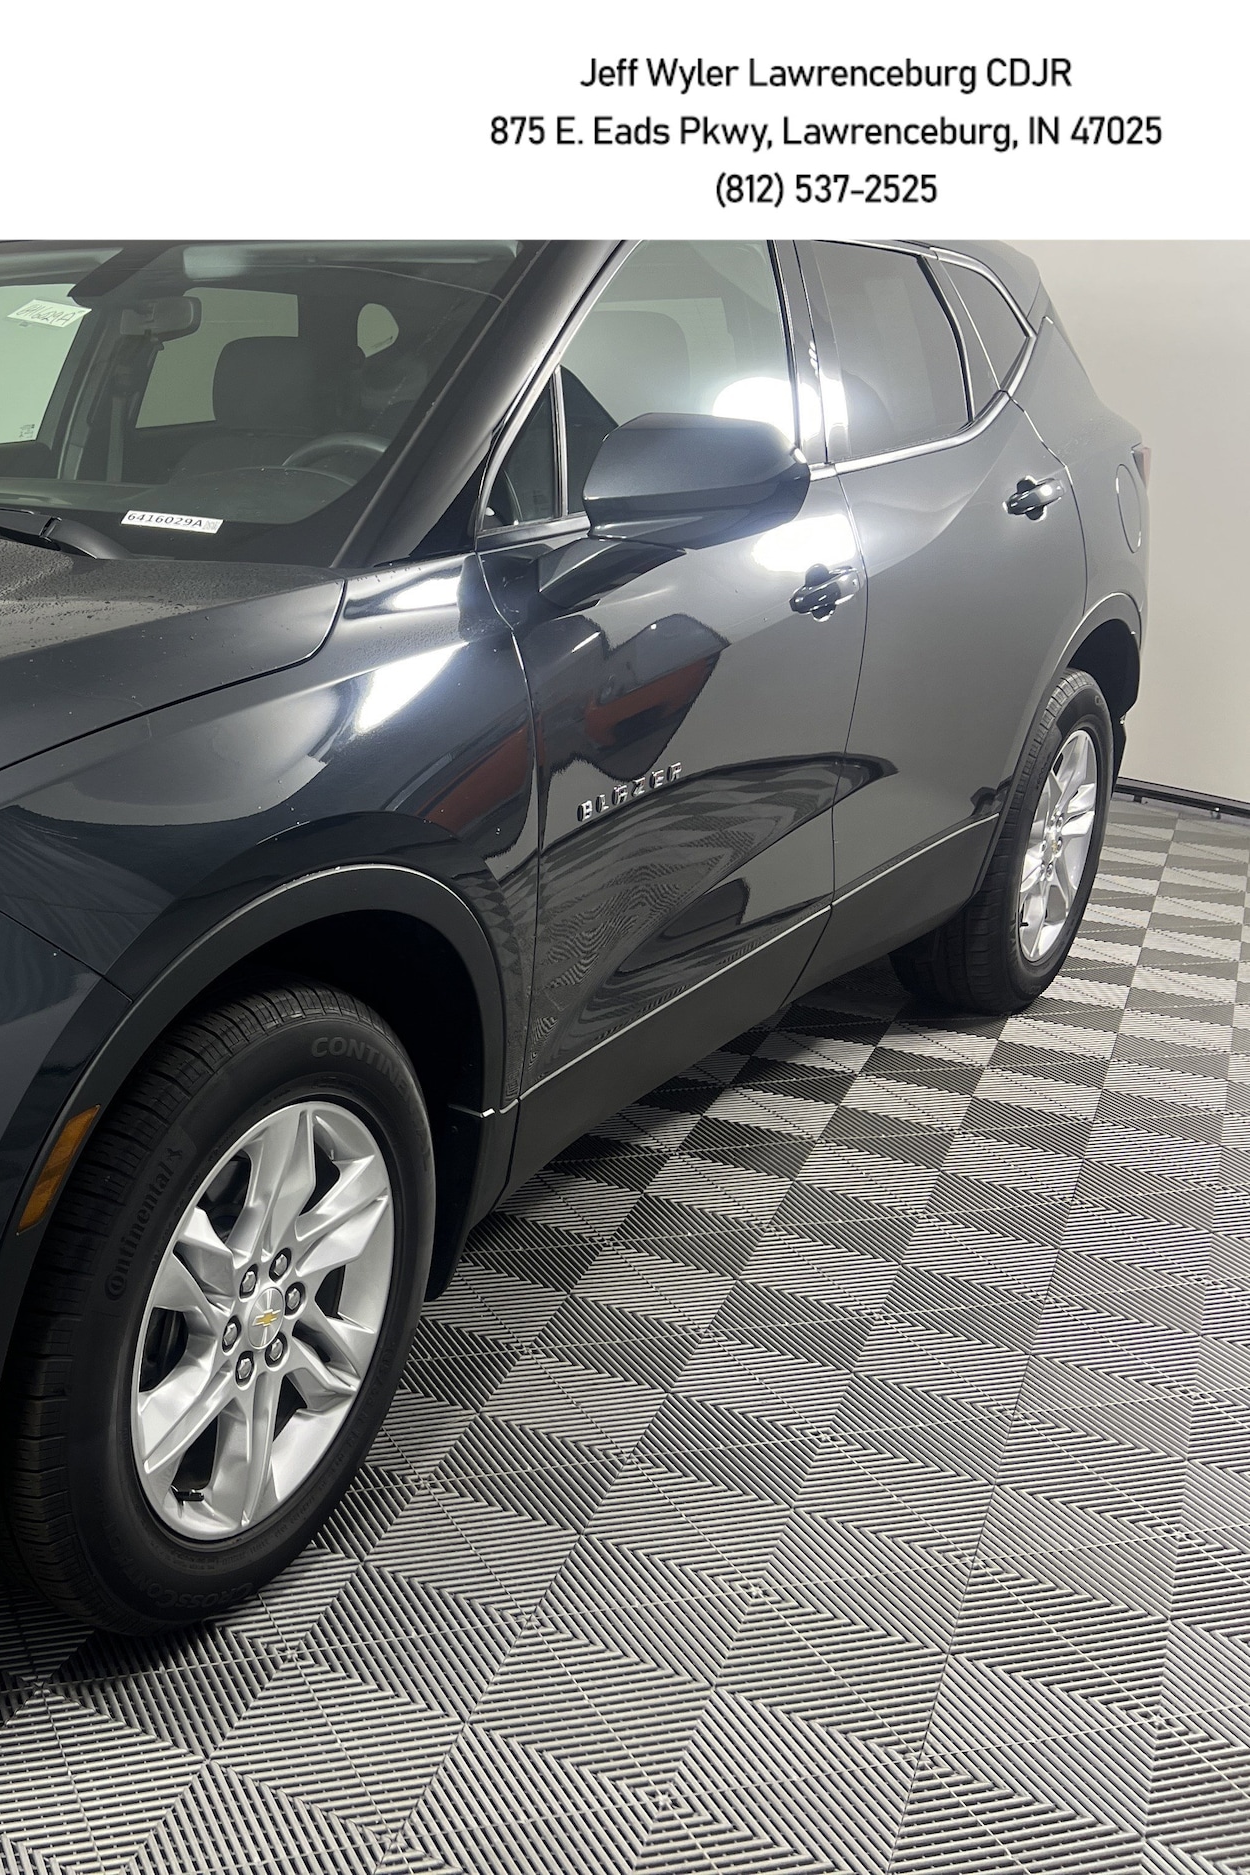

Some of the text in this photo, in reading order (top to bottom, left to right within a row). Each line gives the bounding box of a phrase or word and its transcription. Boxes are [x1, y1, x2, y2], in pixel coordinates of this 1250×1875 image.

[127, 512, 203, 528] 6416029A
[577, 762, 682, 822] BLAZER
[104, 1161, 175, 1300] Continental
